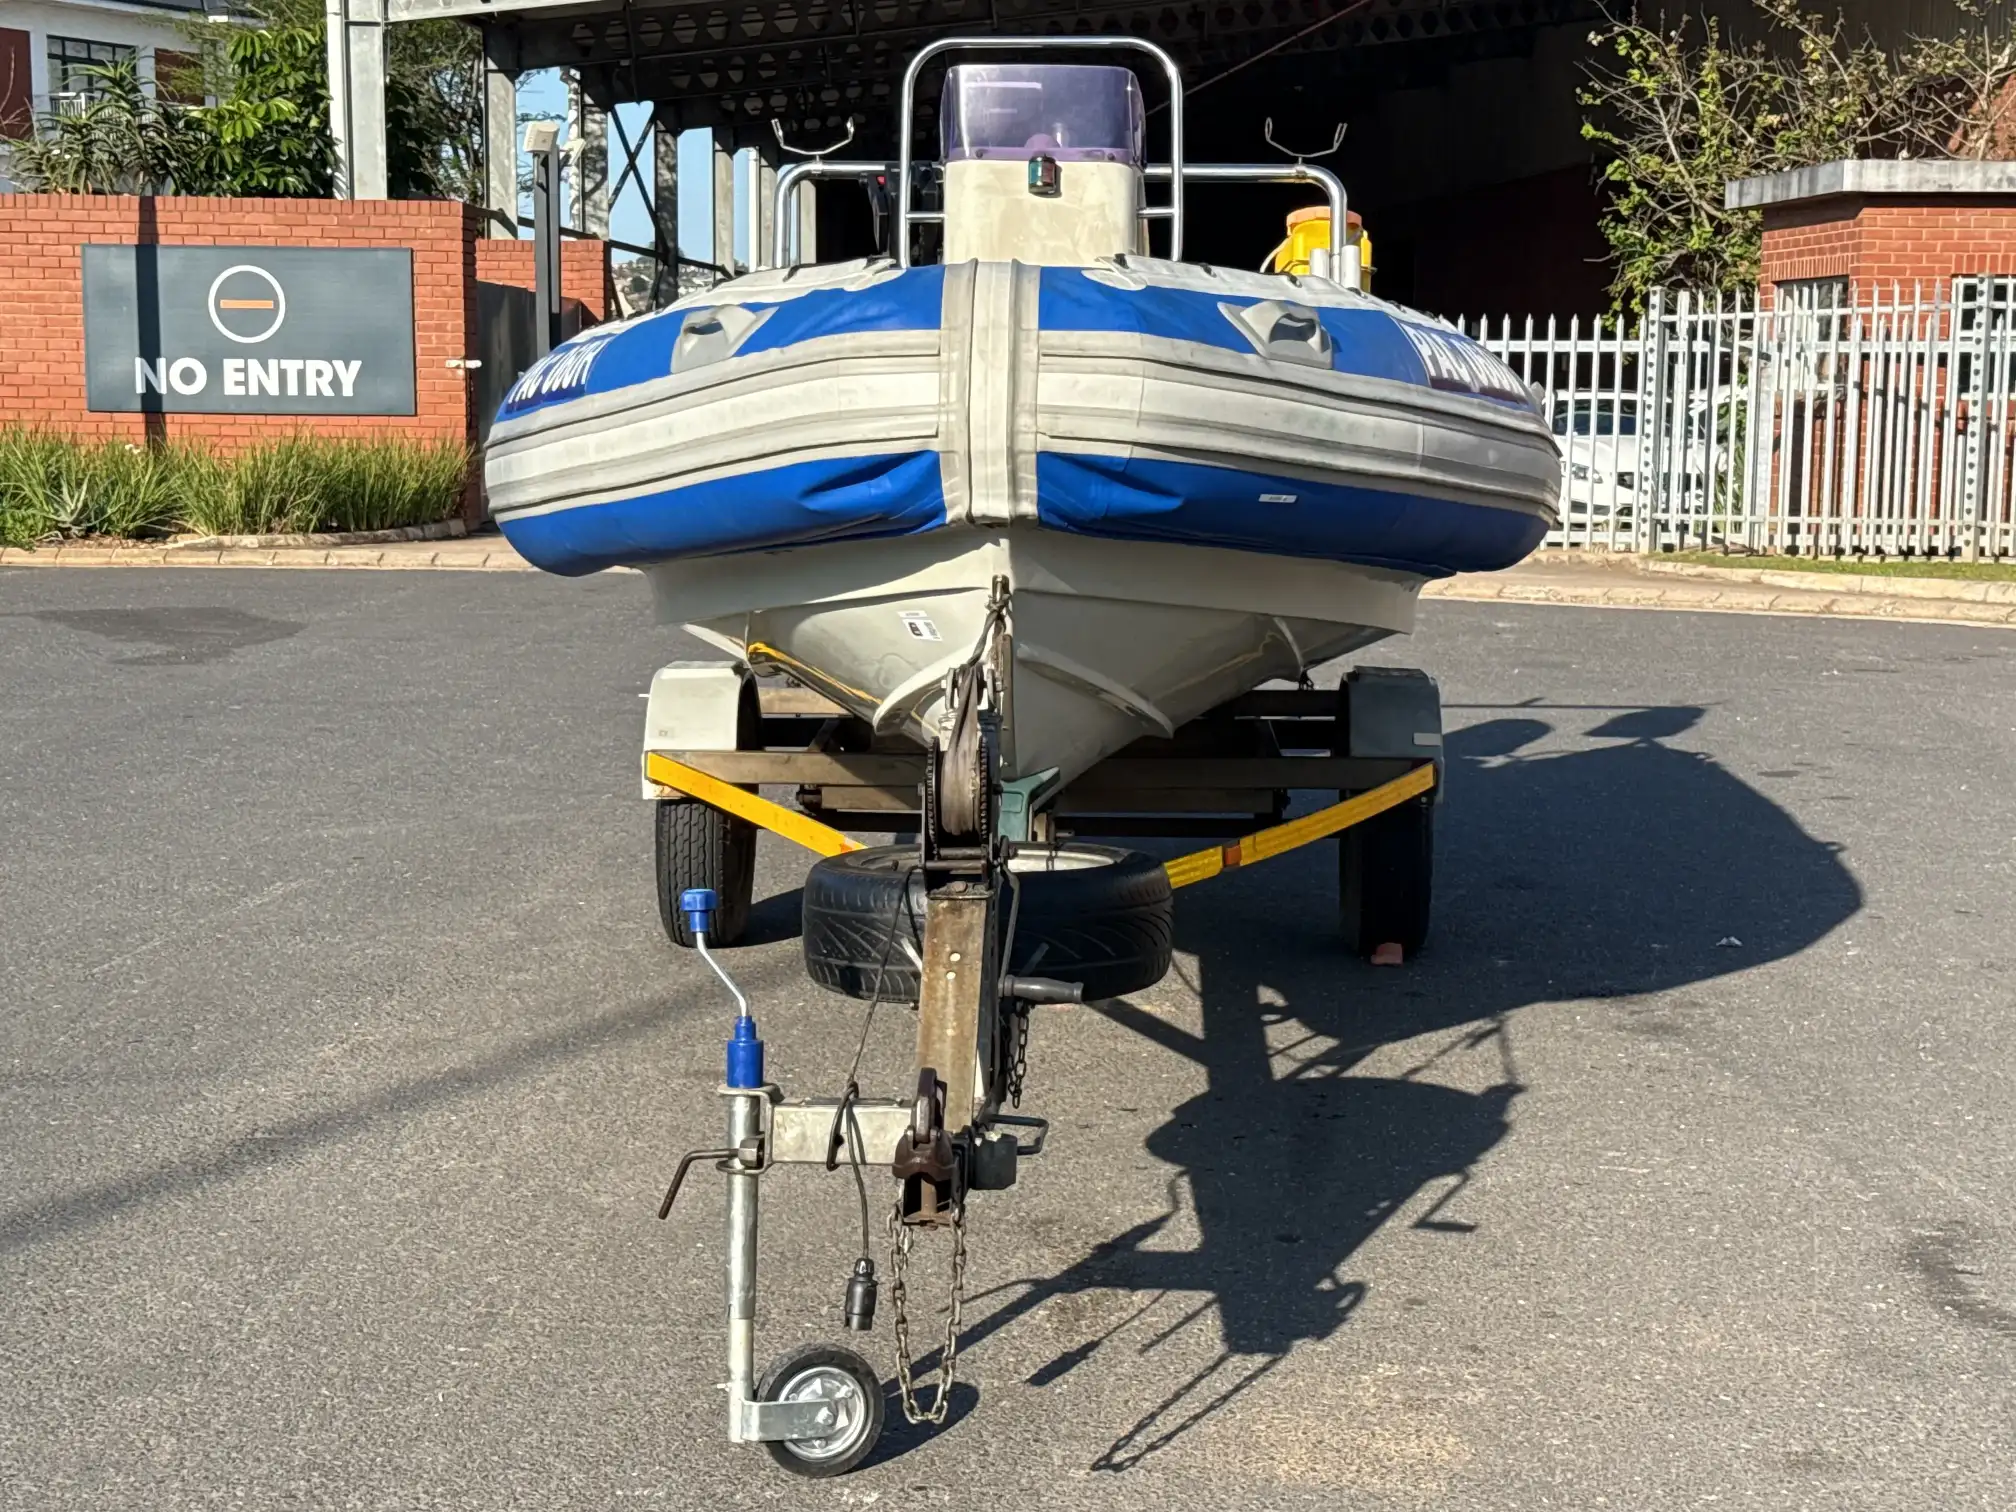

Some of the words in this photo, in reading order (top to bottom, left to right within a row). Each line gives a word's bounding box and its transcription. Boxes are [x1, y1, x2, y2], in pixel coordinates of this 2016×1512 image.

[135, 357, 207, 395] NO
[223, 358, 362, 397] ENTRY
[1400, 322, 1471, 383] PAC
